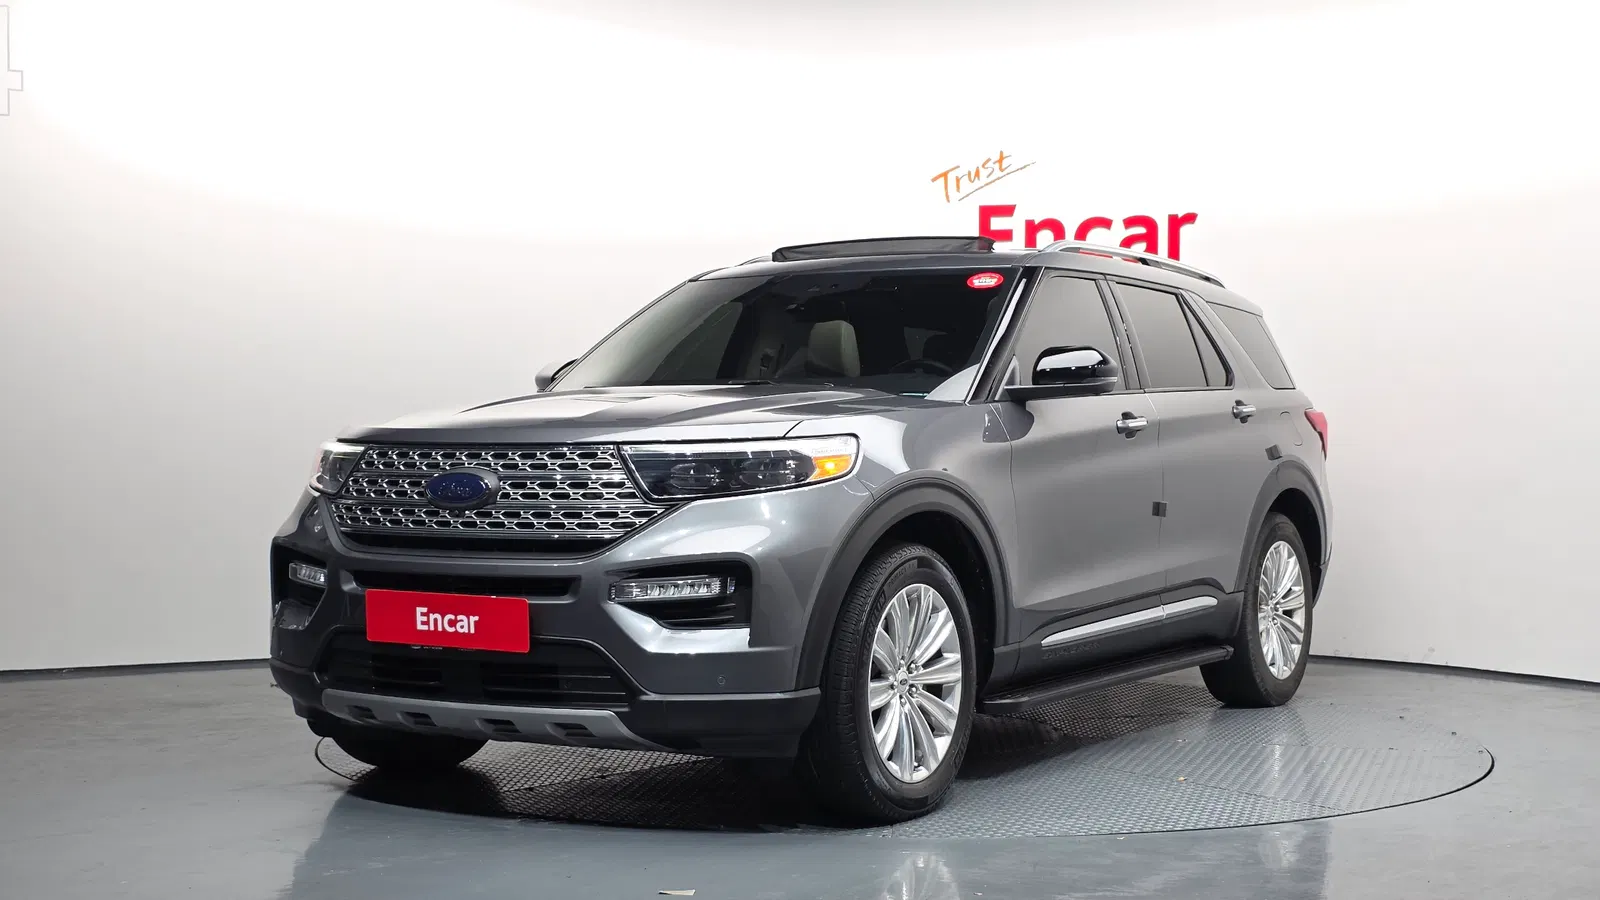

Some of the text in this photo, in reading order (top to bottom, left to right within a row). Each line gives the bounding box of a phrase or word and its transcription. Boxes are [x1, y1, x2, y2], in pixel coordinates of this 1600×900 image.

[931, 150, 1012, 203] Trust
[978, 204, 1198, 261] Encar
[415, 606, 479, 634] Encar
